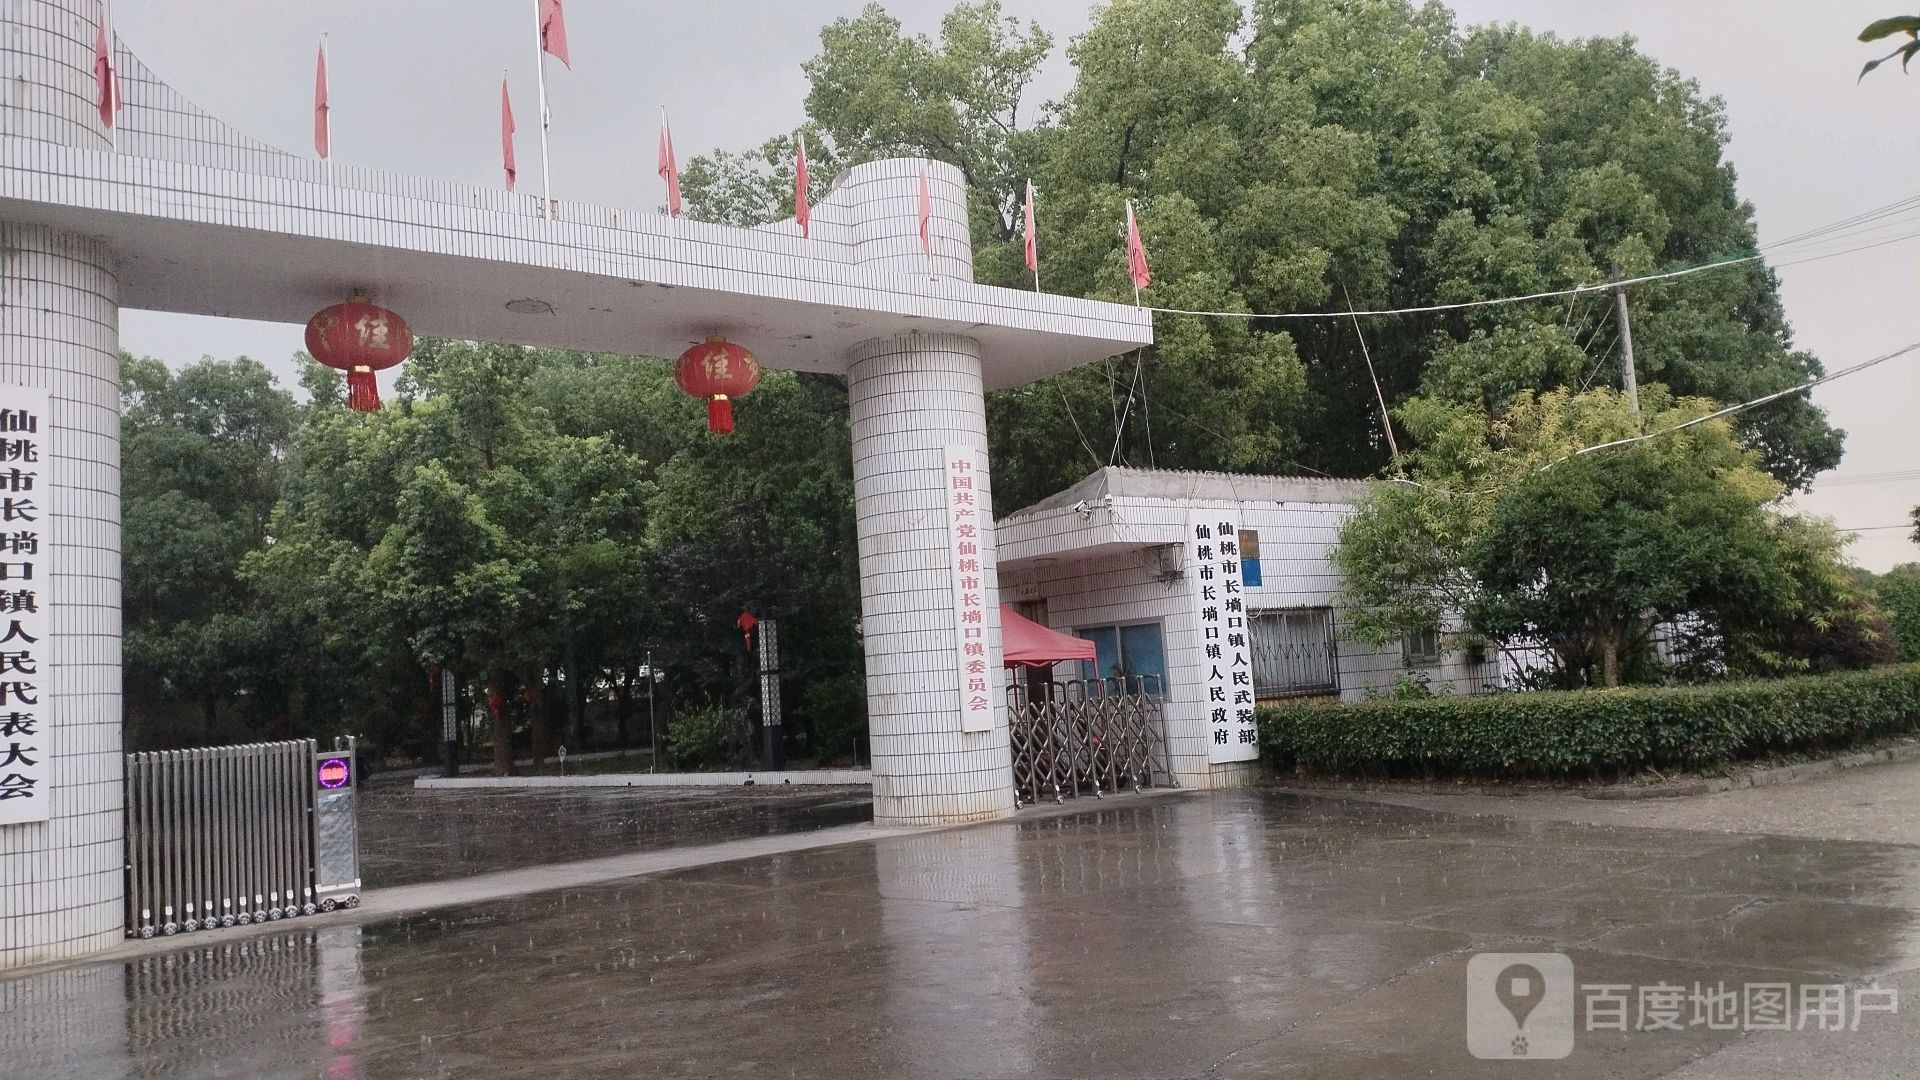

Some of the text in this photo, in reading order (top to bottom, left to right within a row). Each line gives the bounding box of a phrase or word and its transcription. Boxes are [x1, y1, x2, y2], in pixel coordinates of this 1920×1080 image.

[0, 408, 39, 800] 仙桃市长埫口镇人民代表大会
[951, 459, 989, 712] 中国共产党仙桃市长埫口镇委员会
[1195, 523, 1229, 746] 仙桃市长埫口镇人民政府
[1217, 521, 1256, 745] 仙桃市长埫口镇人民武装部
